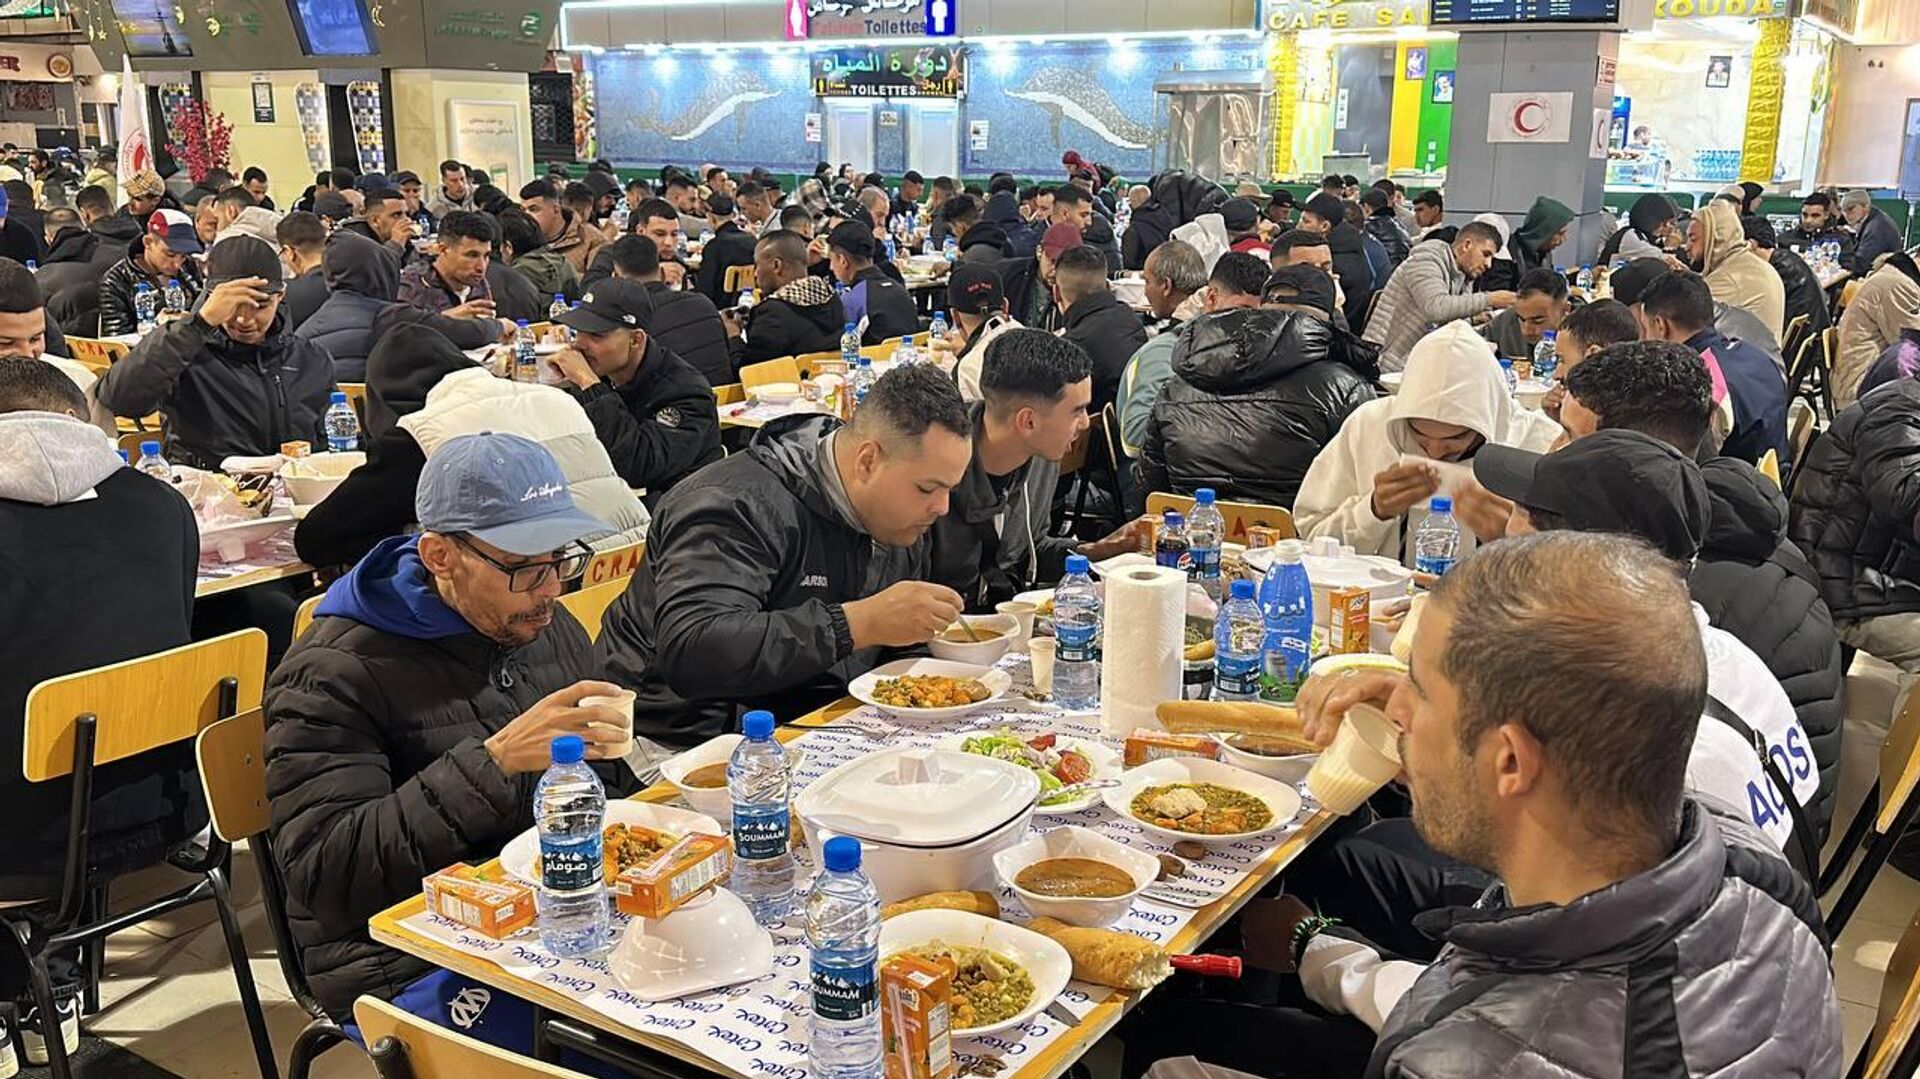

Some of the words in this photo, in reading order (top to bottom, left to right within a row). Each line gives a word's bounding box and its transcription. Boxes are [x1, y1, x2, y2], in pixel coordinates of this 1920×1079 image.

[865, 20, 927, 34] Toilettes
[1269, 11, 1348, 30] CAFE
[823, 53, 879, 77] المياه
[851, 85, 917, 96] TOILETTES
[520, 486, 538, 501] Los
[593, 549, 638, 582] CRA
[739, 831, 785, 842] SOUMMAM
[545, 860, 588, 874] صومام
[1129, 907, 1178, 926] Cotex
[457, 935, 504, 951] Cotex
[512, 946, 560, 968] Cotex
[547, 973, 596, 992] Cotex
[673, 997, 724, 1013] Cotex
[643, 1015, 696, 1030] Cotex
[736, 1009, 789, 1034] Cotex
[1015, 1022, 1048, 1037] Cot
[709, 1025, 762, 1051] Cotex
[971, 1035, 1027, 1055] Cotex
[751, 1058, 807, 1079] Cotex
